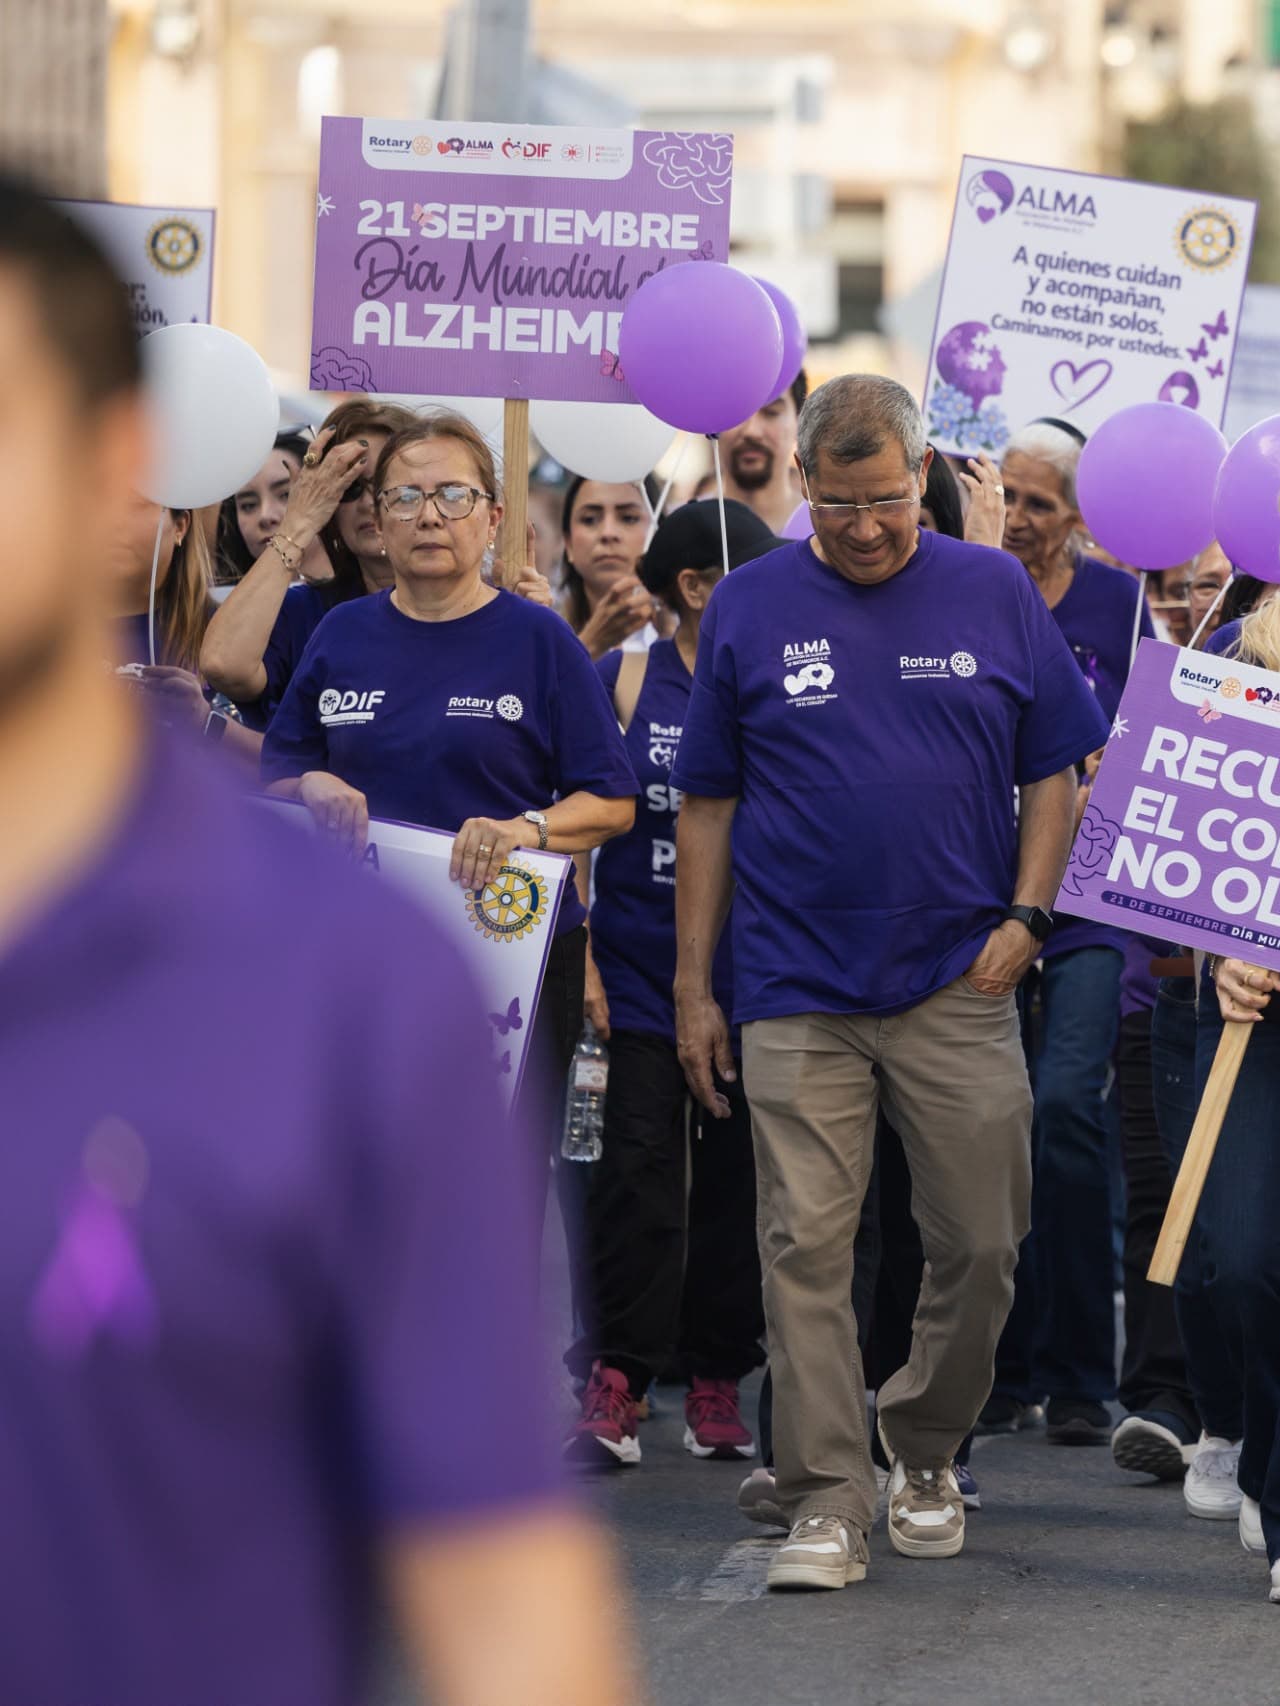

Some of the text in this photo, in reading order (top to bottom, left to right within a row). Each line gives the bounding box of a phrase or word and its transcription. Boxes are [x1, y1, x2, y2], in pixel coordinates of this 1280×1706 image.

[369, 136, 552, 158] Rotary ALMA DIF
[1017, 185, 1097, 219] ALMA
[356, 200, 700, 250] 21 SEPTIEMBRE
[353, 237, 445, 301] Día
[453, 240, 630, 307] Mundial
[1012, 245, 1182, 290] A quienes cuidan
[1026, 275, 1165, 315] y acompañan,
[1021, 299, 1163, 336] no están solos.
[991, 313, 1183, 360] Caminamos por ustedes.
[783, 638, 831, 658] ALMA
[900, 656, 947, 670] Rotary
[1180, 668, 1221, 689] Rotary
[339, 690, 386, 711] DIF
[448, 696, 494, 711] Rotary
[1122, 785, 1185, 842] EL
[501, 865, 531, 881] OTARY
[1105, 834, 1202, 899] NO
[1110, 894, 1124, 907] 21
[1130, 899, 1146, 912] DE
[1149, 903, 1227, 934] SEPTIEMBRE
[1231, 926, 1253, 940] DÍA
